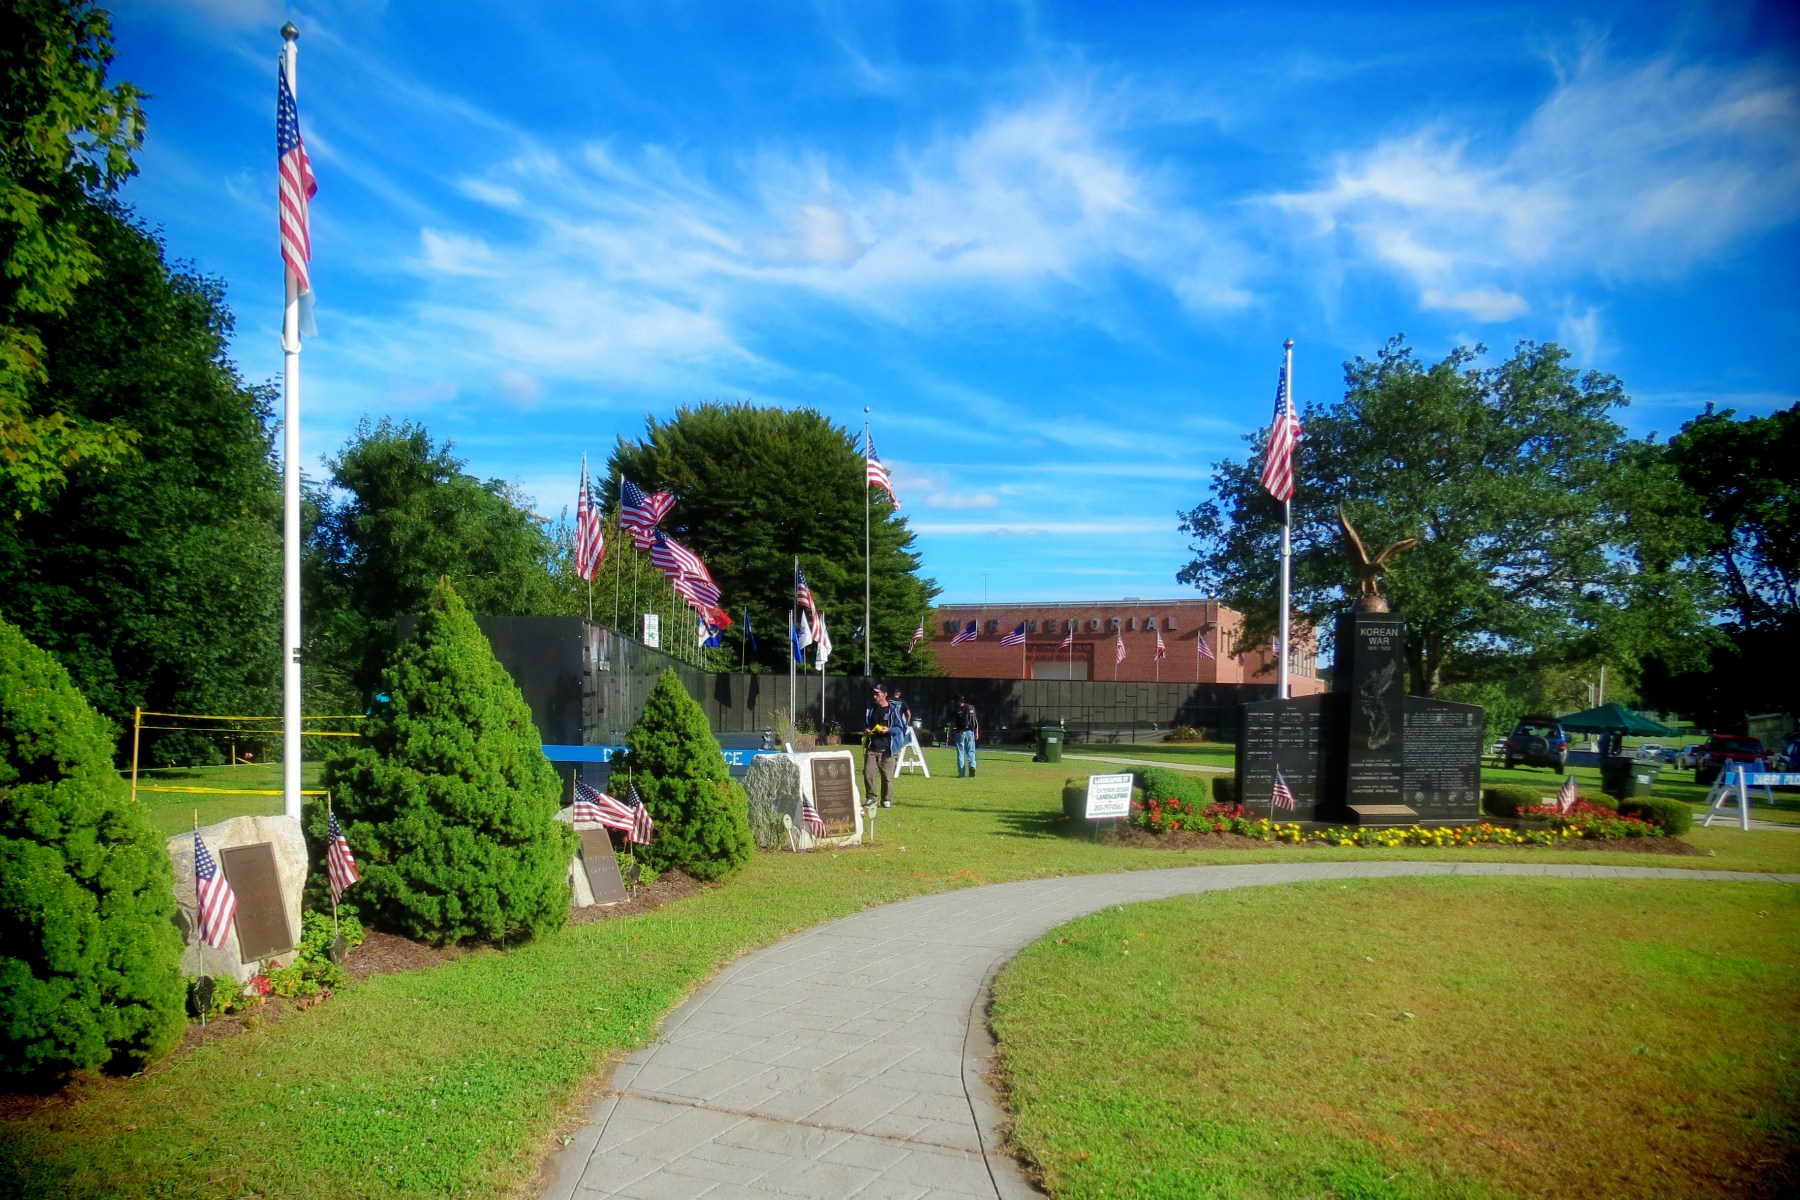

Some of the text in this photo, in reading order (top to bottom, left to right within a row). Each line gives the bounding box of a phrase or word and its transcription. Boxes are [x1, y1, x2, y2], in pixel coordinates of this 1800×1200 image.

[946, 616, 1177, 633] WR MEMORIAL
[1360, 628, 1398, 636] KOREAN
[1368, 637, 1390, 645] WAR
